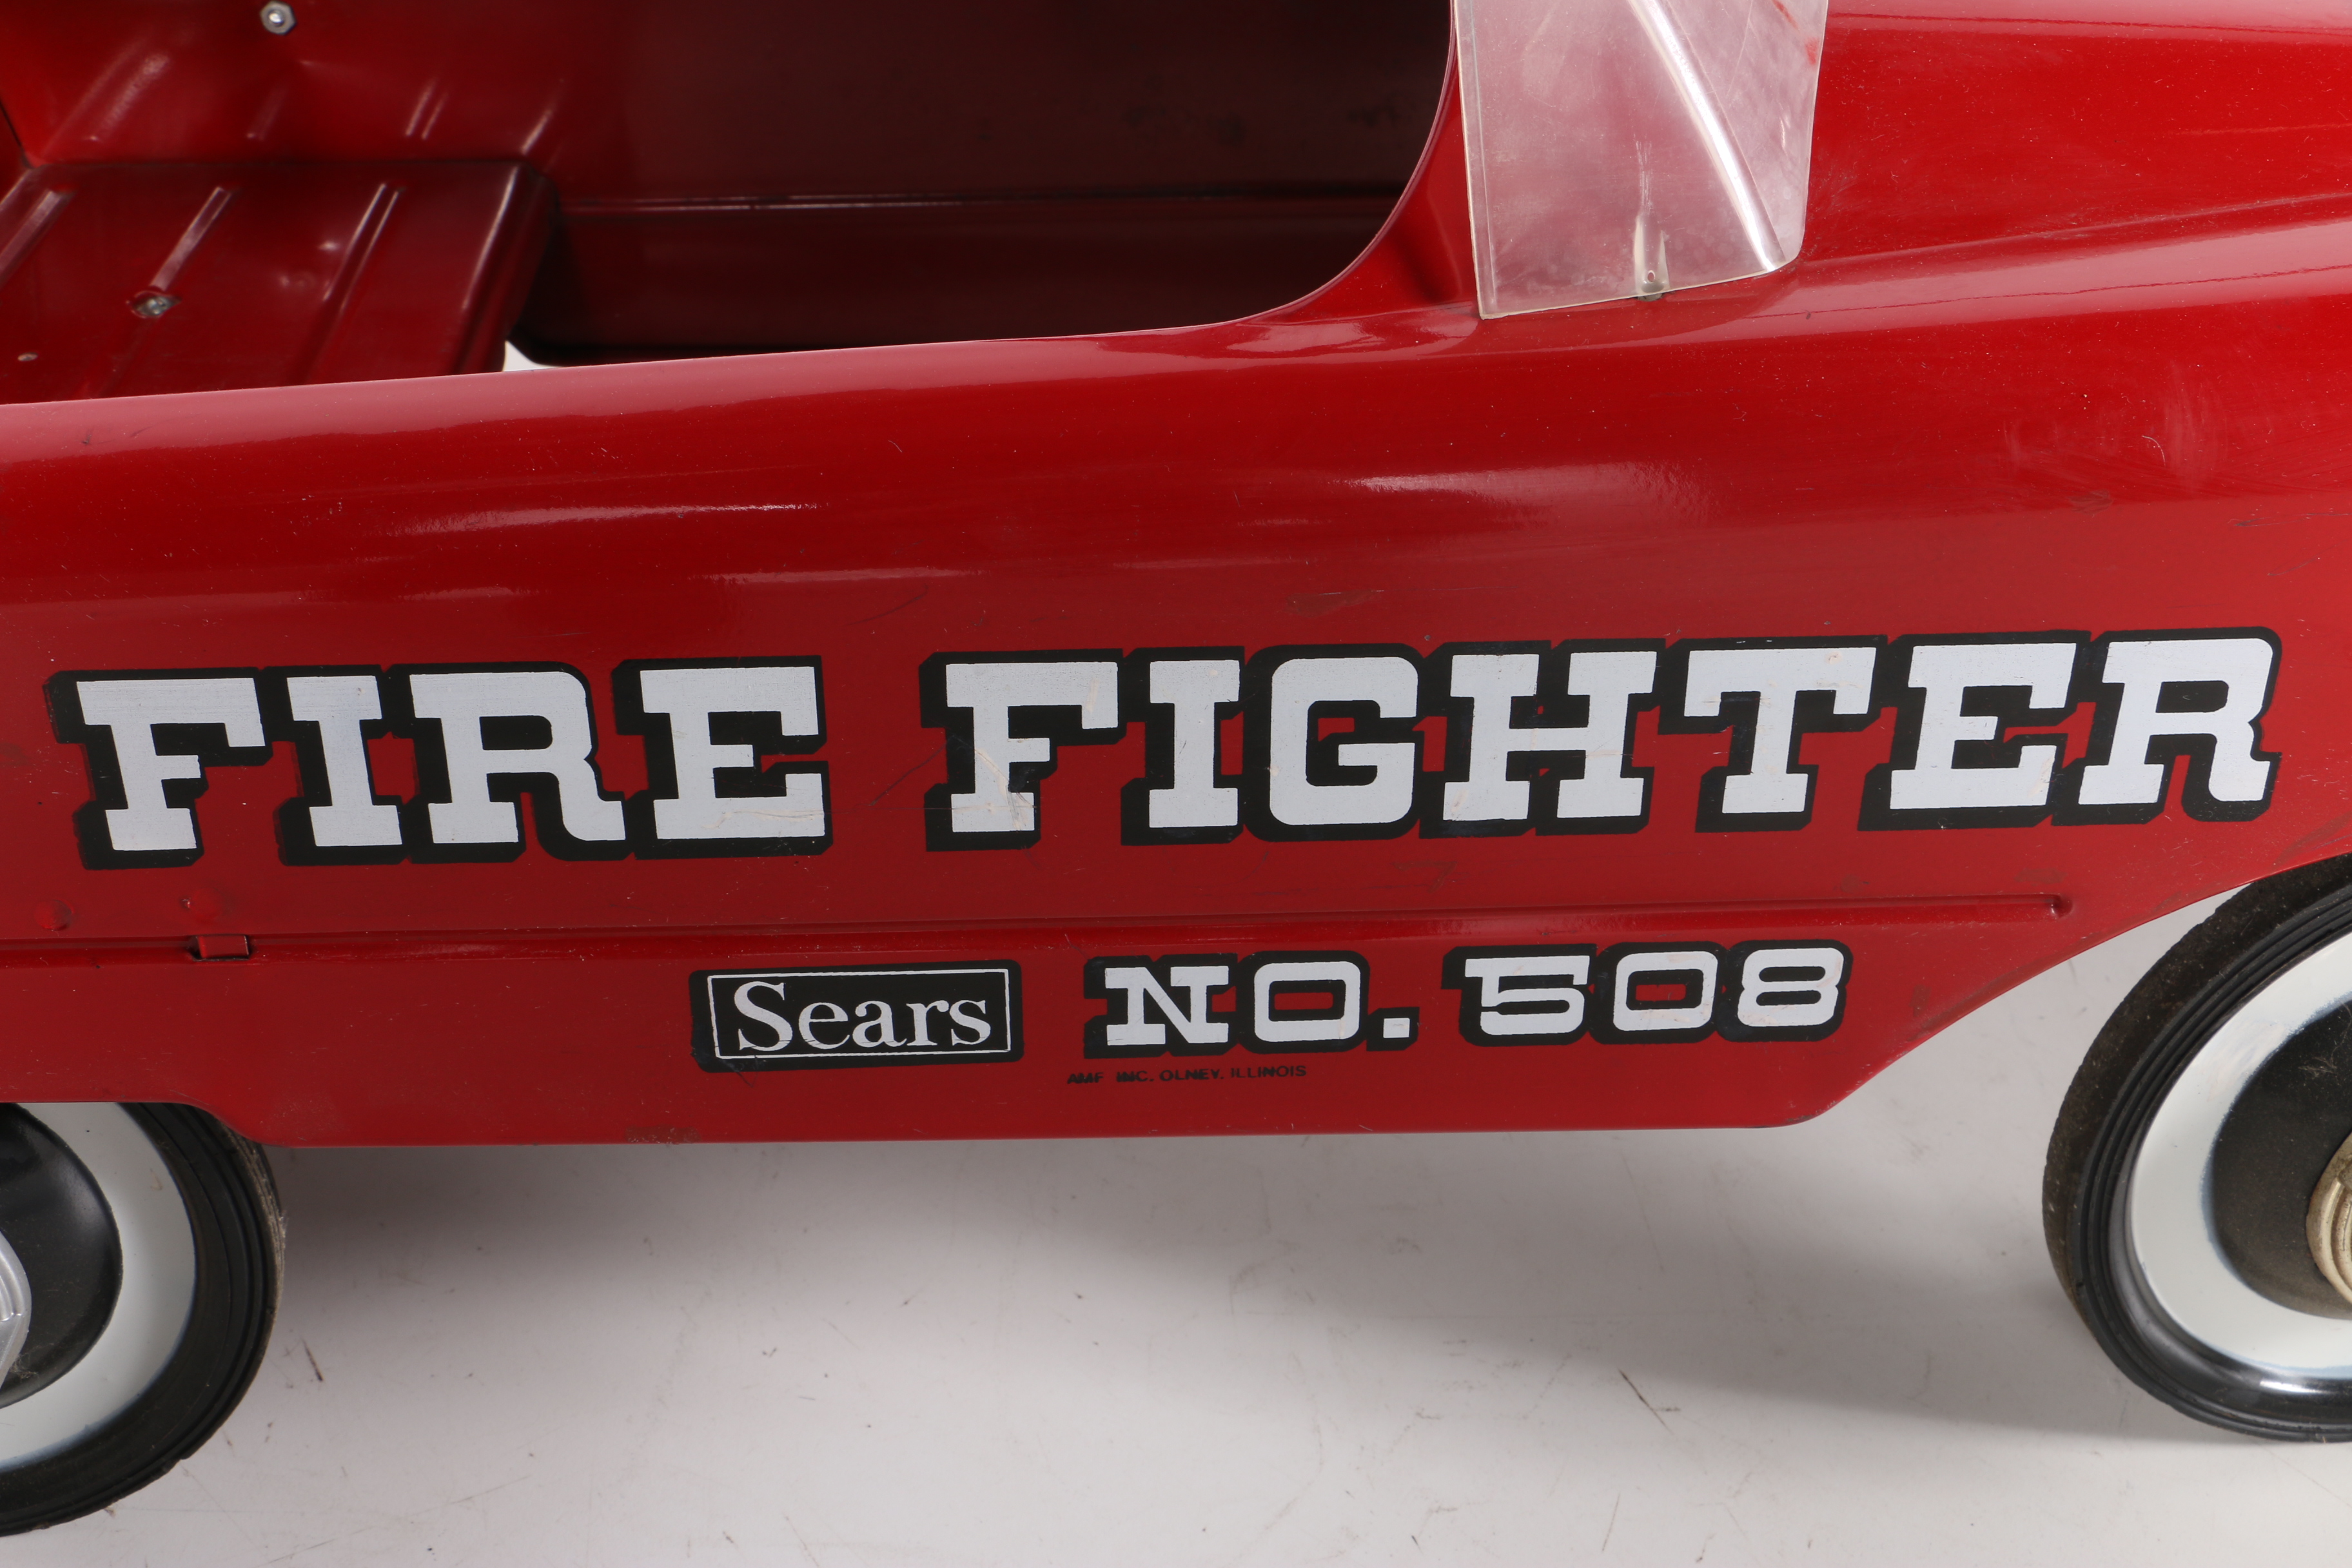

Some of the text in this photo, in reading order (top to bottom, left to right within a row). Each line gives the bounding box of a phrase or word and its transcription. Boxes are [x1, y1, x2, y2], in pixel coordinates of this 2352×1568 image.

[75, 637, 2274, 851] FIRE FIGHTER
[733, 980, 992, 1052] Sears
[1104, 946, 1845, 1046] NO. 508
[1067, 1072, 1104, 1084] AMF
[1116, 1070, 1155, 1083] INC.
[1230, 1064, 1307, 1079] ILLINOIS
